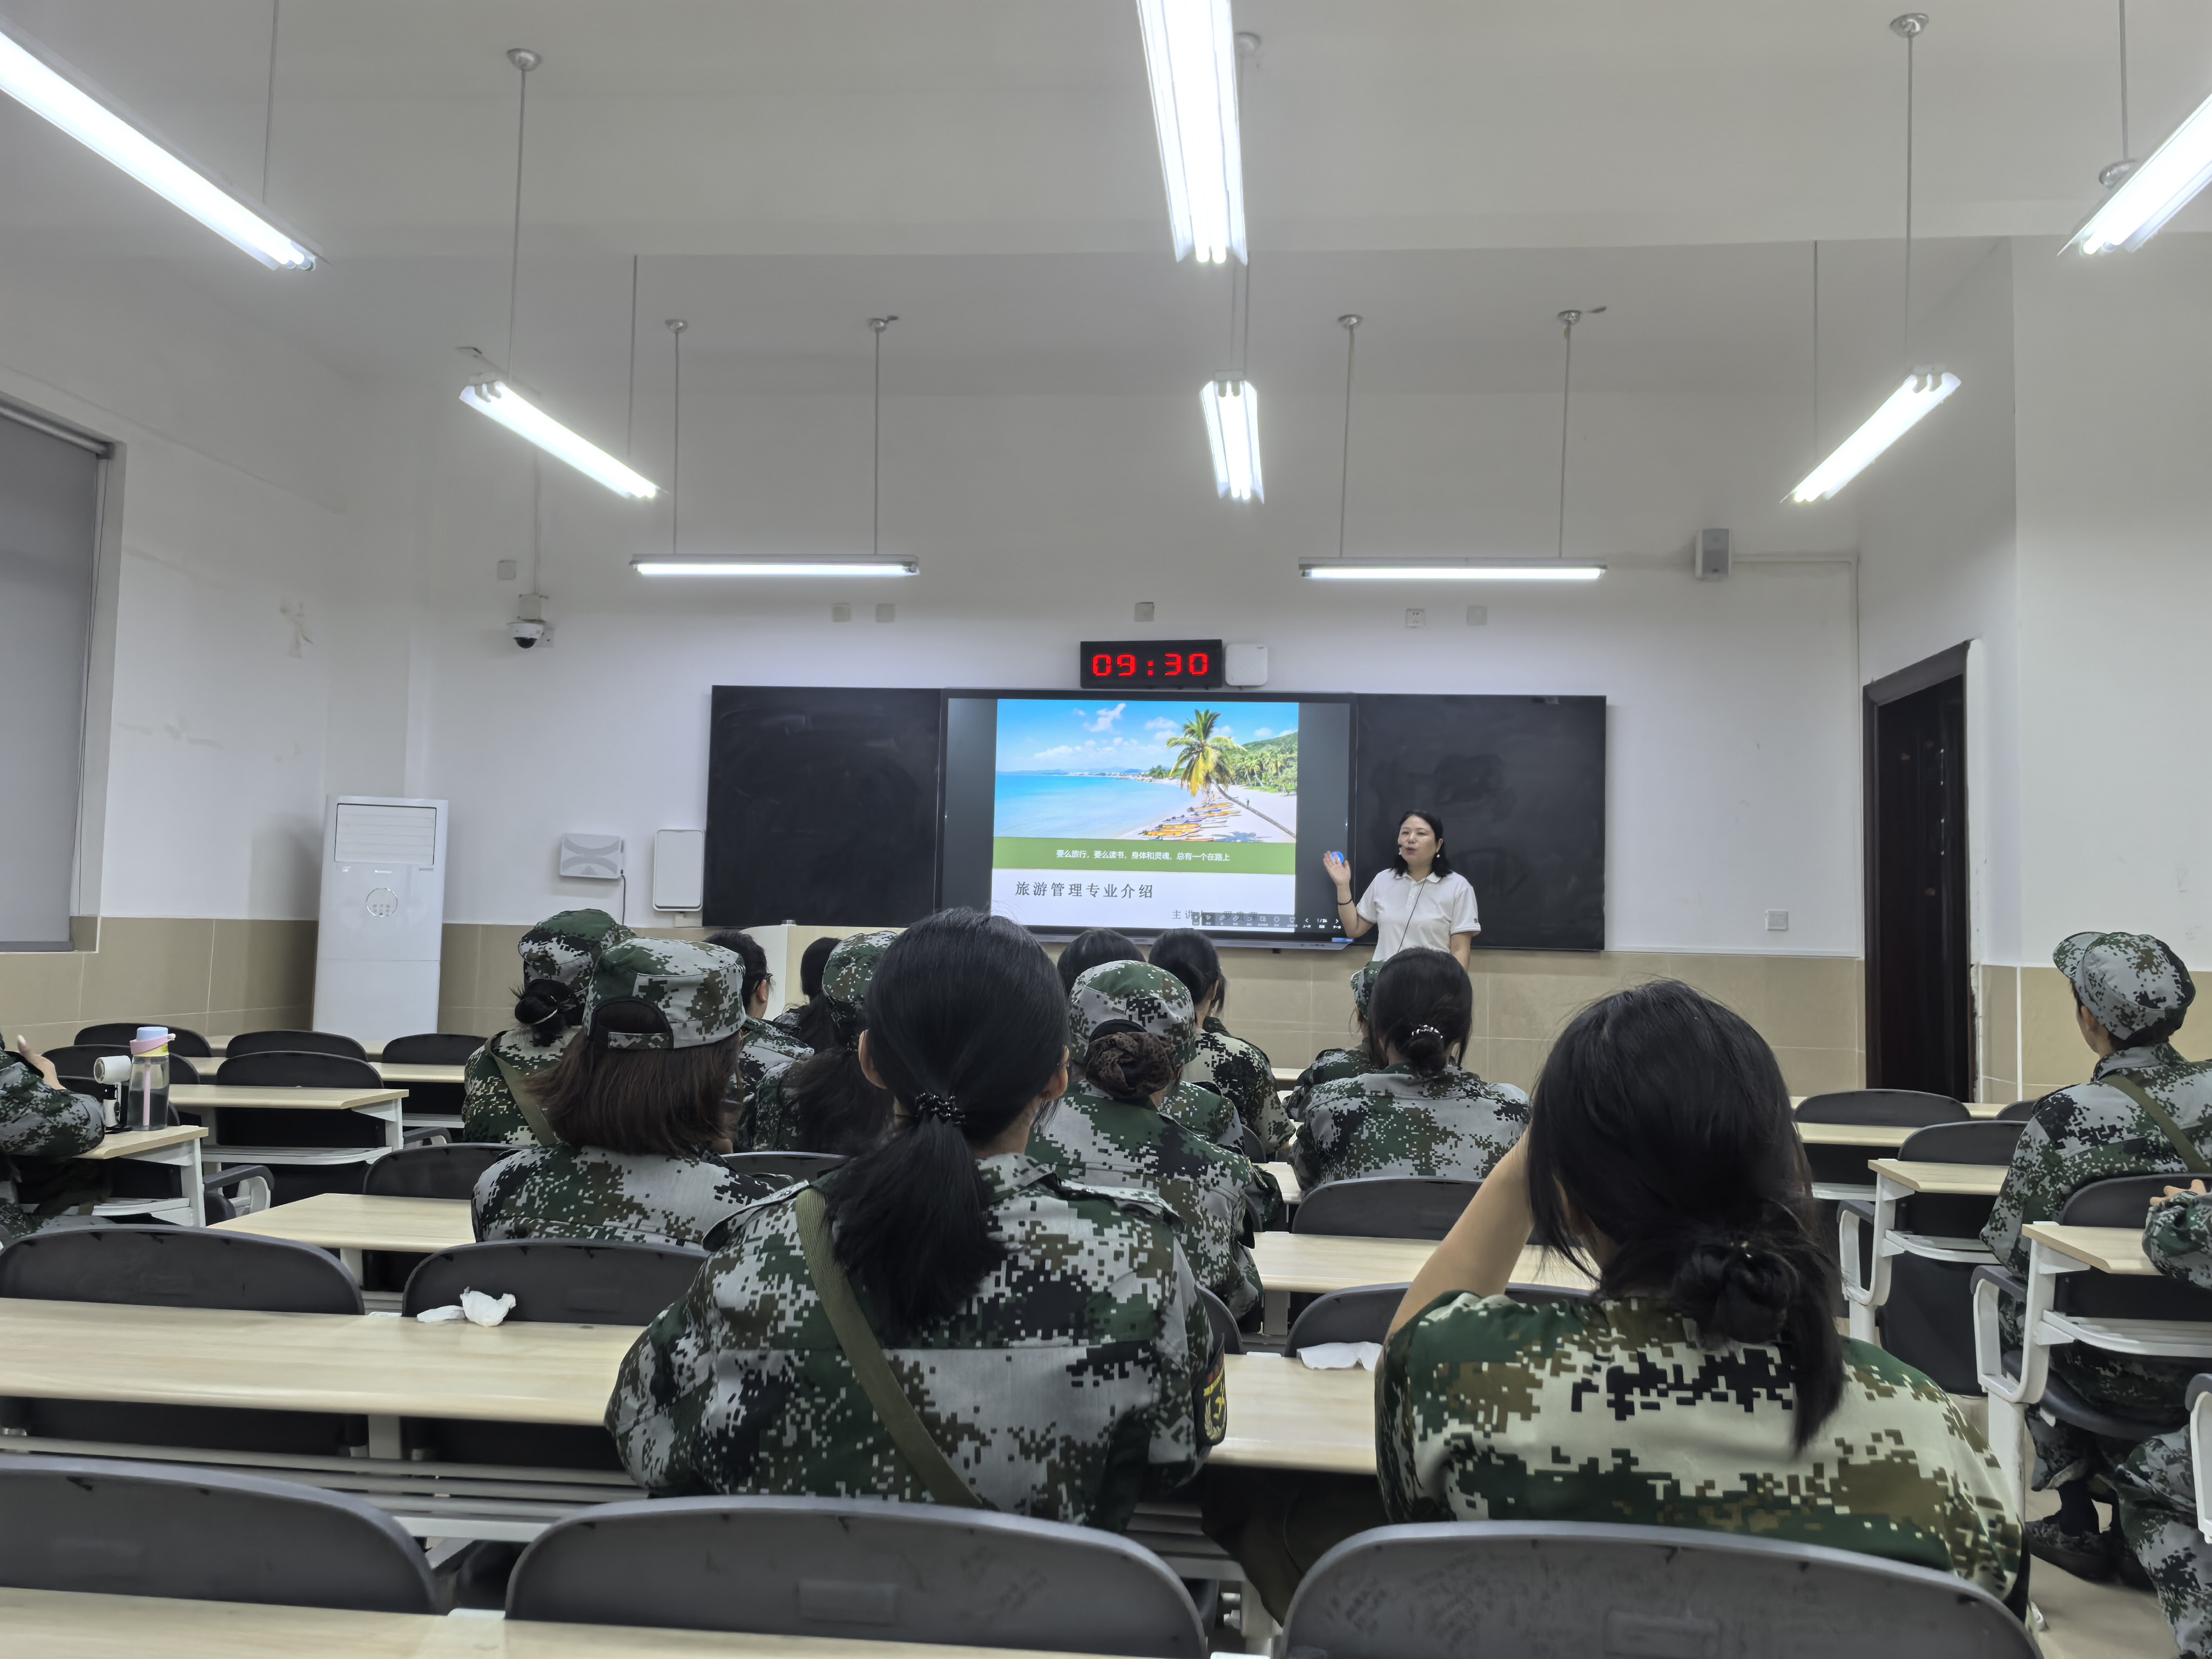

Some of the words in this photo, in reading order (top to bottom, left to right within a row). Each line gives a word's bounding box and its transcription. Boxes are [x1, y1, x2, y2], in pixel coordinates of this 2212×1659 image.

[1092, 653, 1208, 676] 09:30
[1015, 881, 1154, 899] 旅游管理专业介绍
